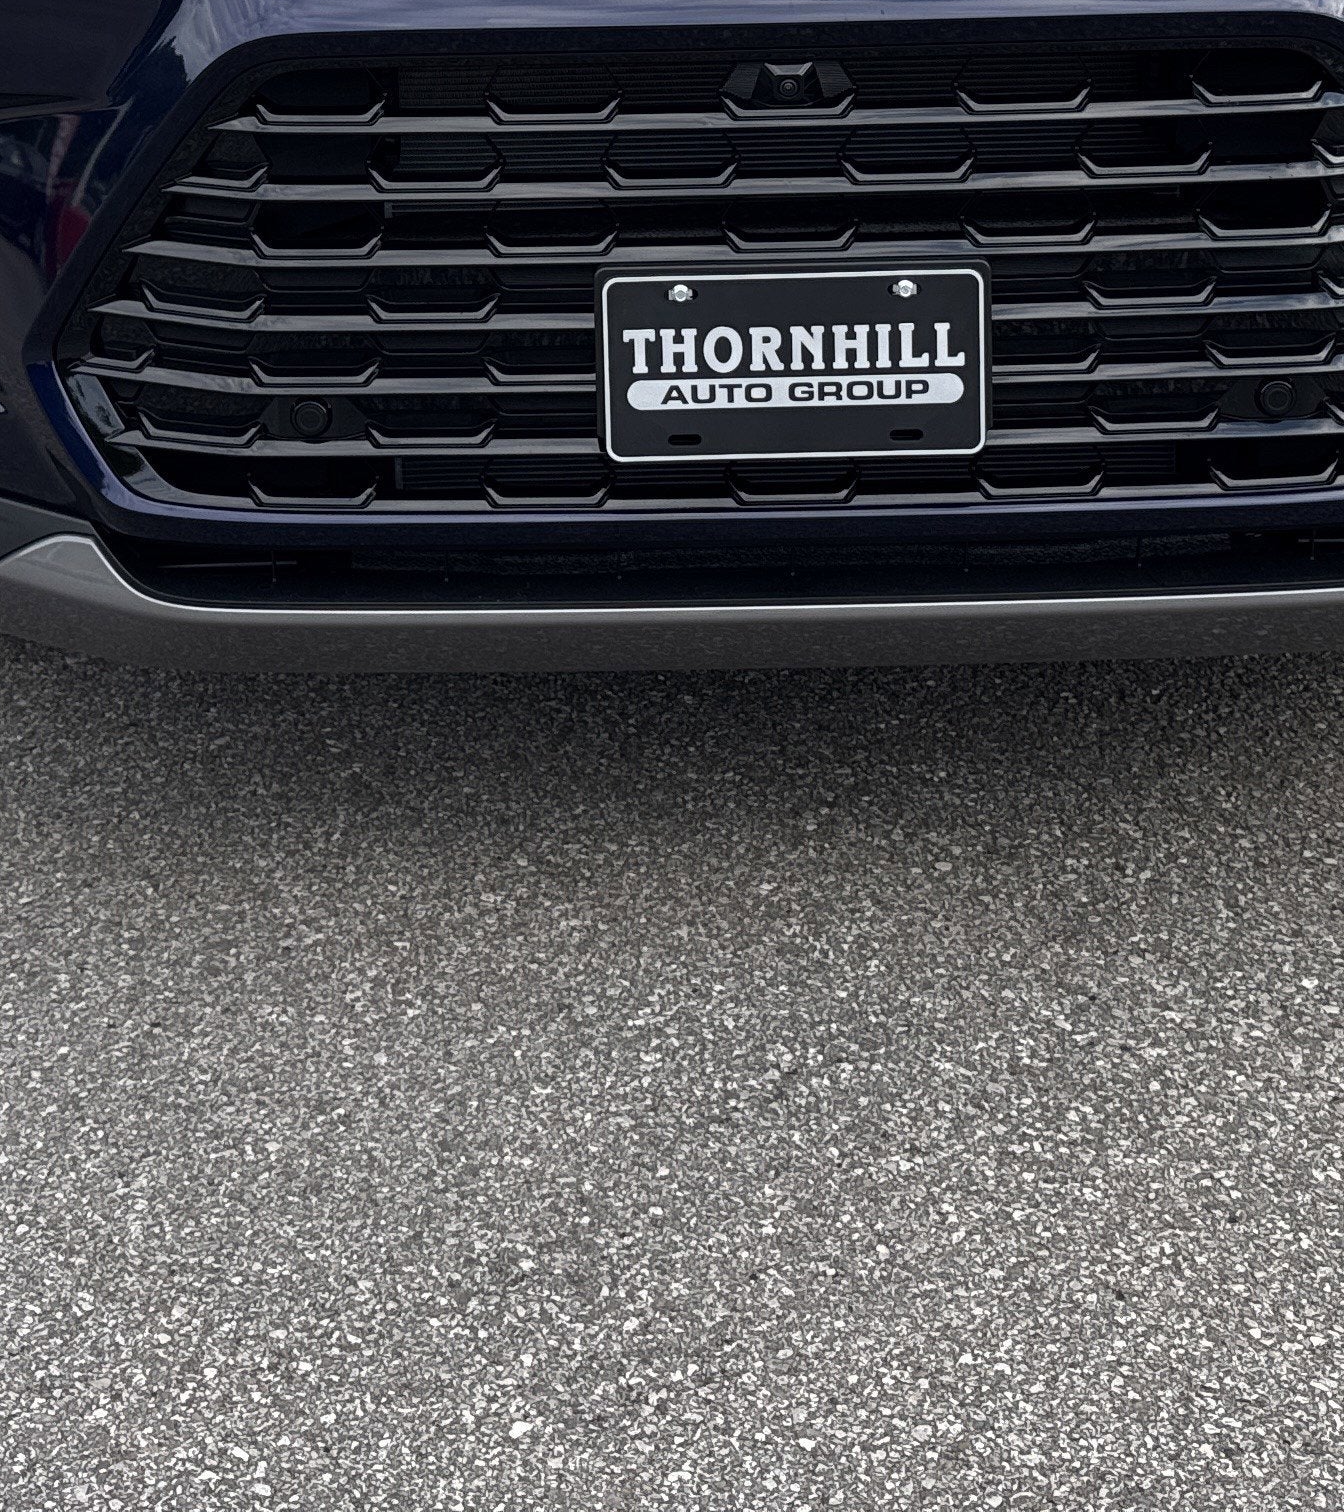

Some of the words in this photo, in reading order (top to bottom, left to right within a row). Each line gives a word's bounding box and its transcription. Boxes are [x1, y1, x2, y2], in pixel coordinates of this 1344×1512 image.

[622, 322, 966, 374] THORNHILL
[660, 382, 773, 405] AUTO
[788, 379, 930, 402] GROUP
